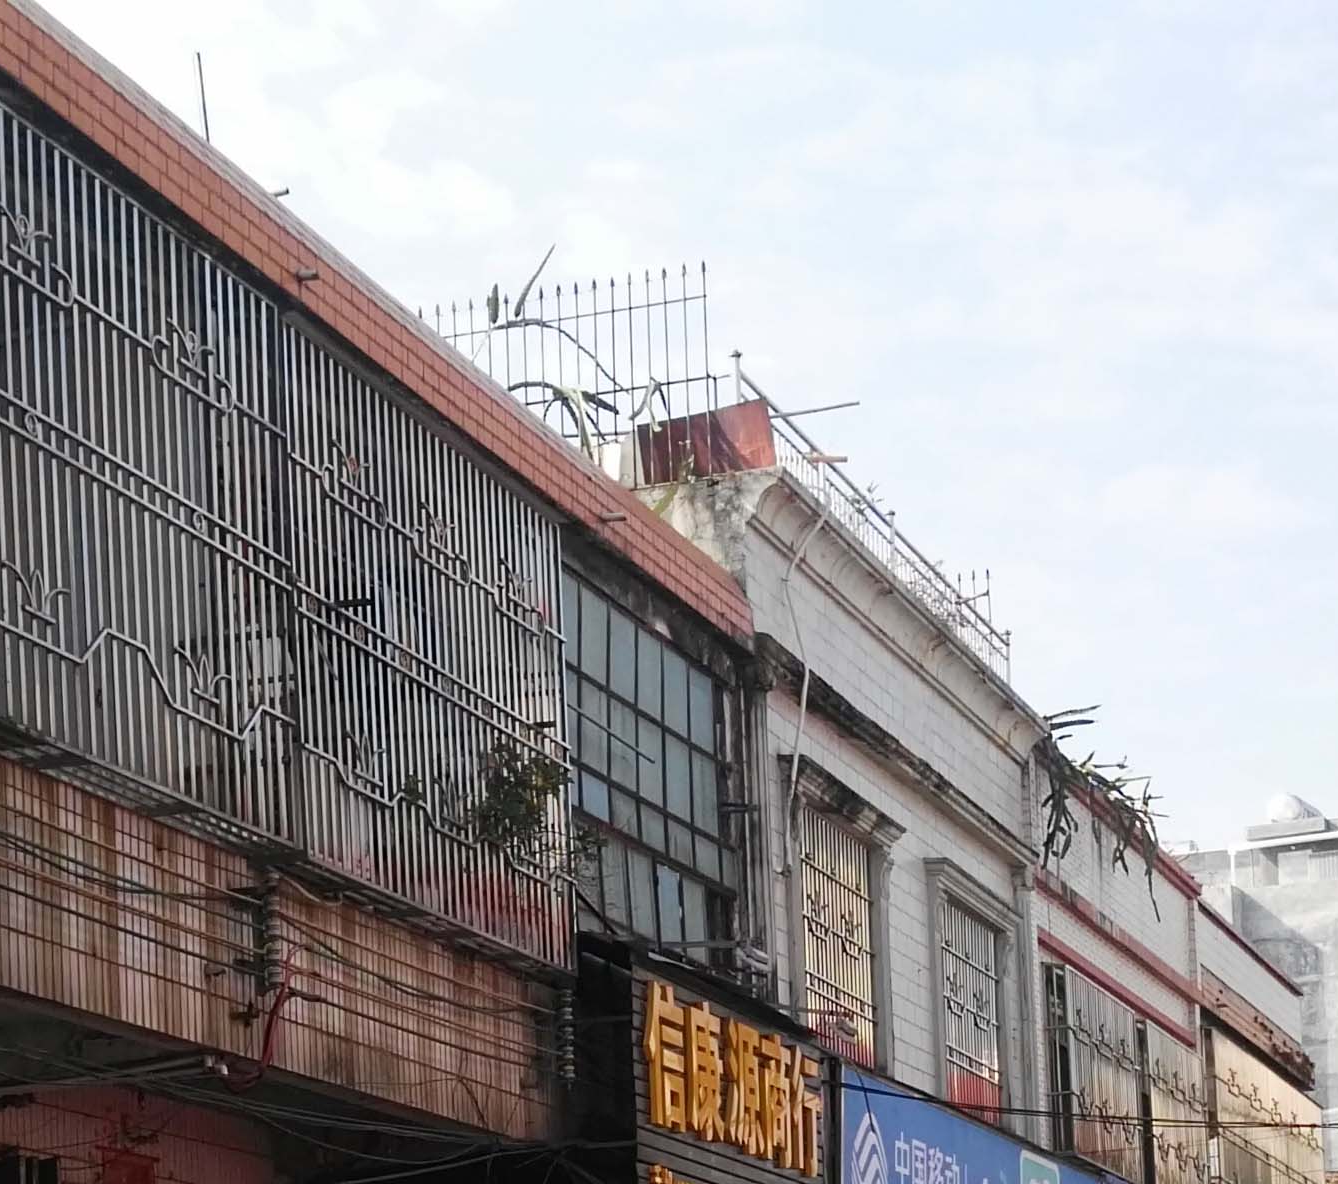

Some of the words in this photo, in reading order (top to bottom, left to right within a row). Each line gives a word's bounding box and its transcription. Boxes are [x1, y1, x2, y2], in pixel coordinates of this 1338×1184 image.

[644, 980, 823, 1178] 信康源商行
